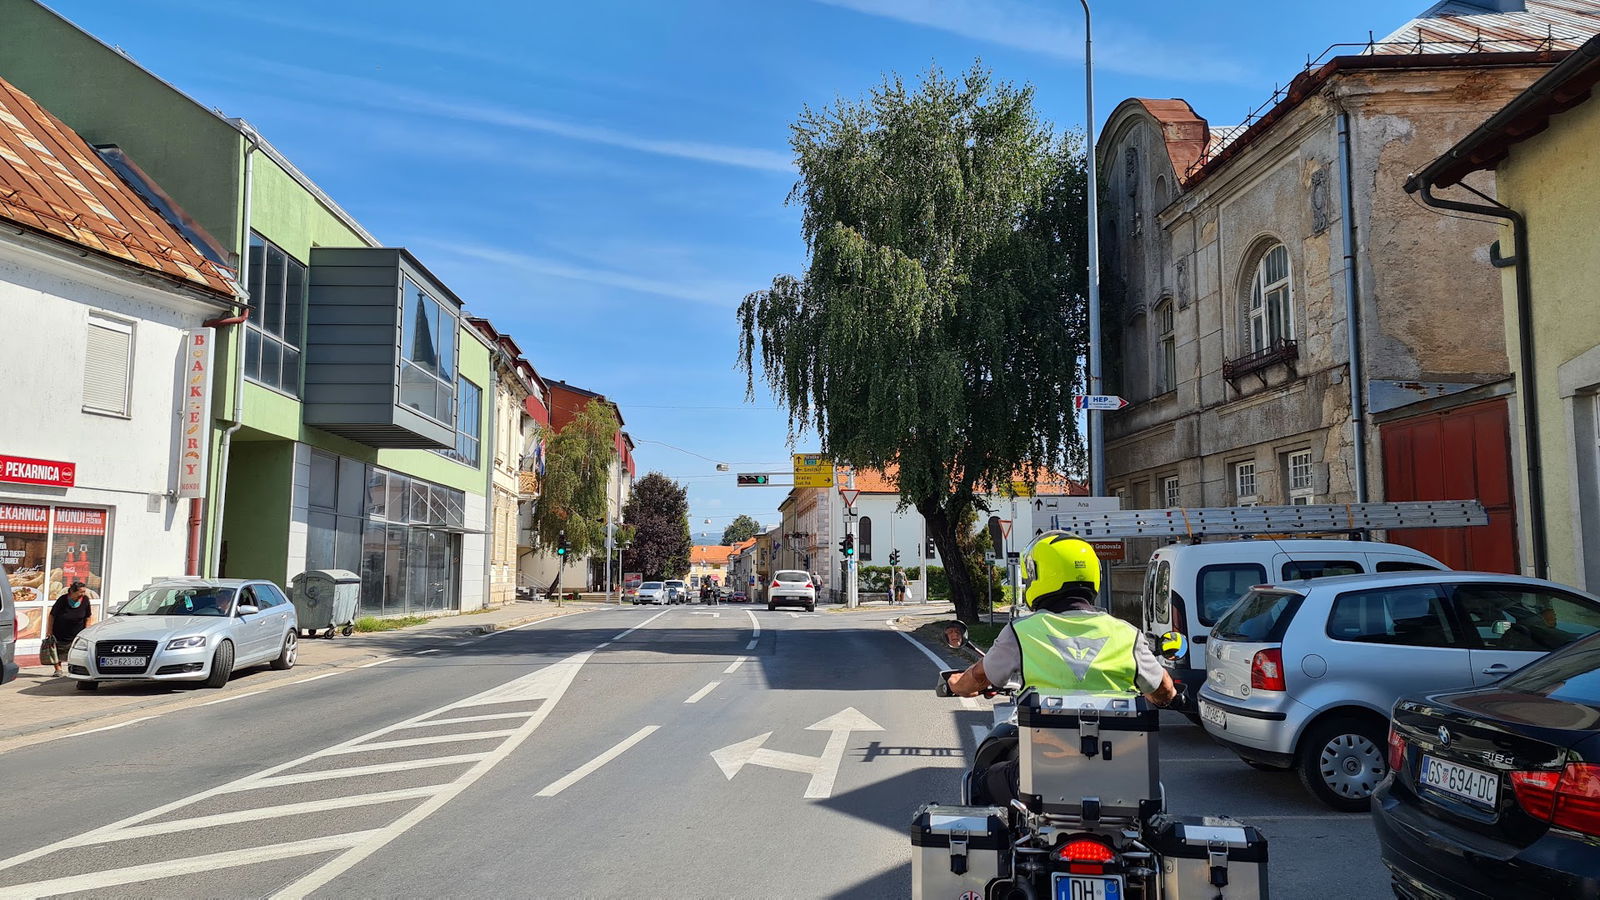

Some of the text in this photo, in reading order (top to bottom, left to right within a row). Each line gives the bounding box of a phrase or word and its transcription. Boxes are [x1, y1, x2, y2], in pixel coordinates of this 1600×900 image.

[185, 334, 205, 475] BAKERY
[5, 461, 60, 481] PEKARNICA
[0, 506, 46, 521] EKARNICA
[57, 510, 85, 523] MONDI
[1428, 761, 1442, 784] GS
